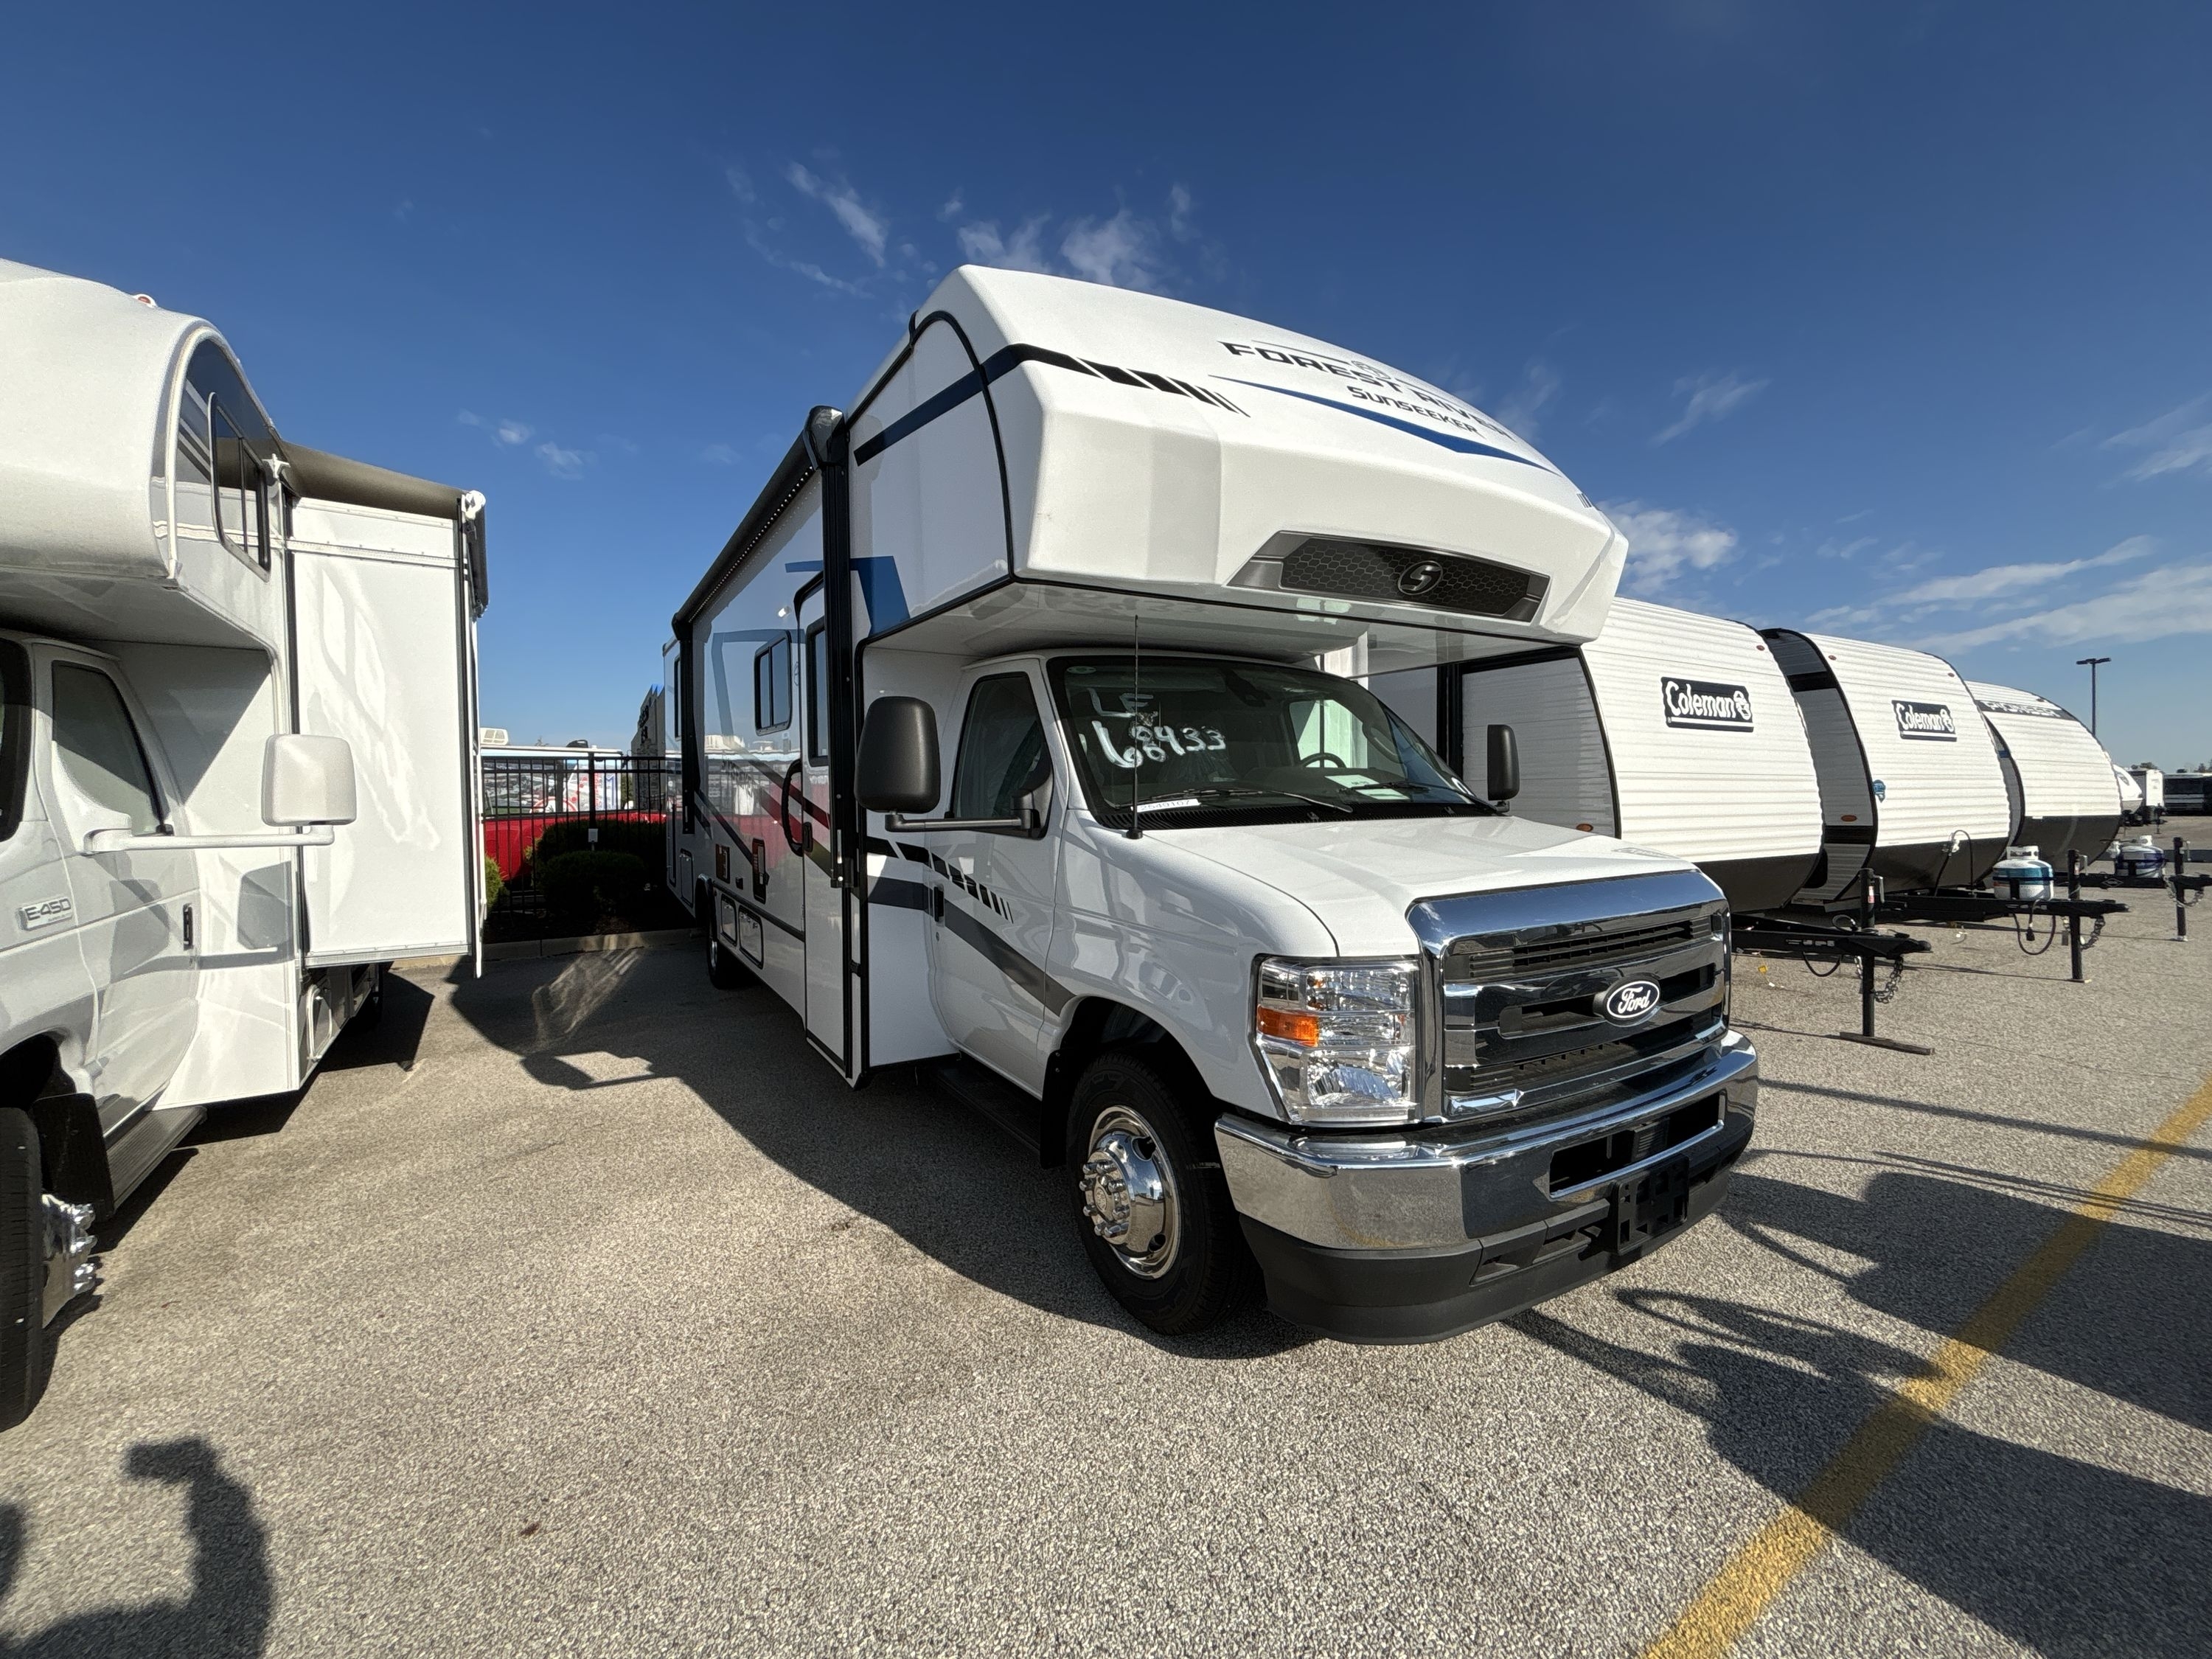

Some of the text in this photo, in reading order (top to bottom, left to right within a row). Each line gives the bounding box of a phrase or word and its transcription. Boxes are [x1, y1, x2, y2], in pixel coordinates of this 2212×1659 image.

[1217, 340, 1402, 393] FOREST
[1665, 681, 1736, 719] Coleman
[1896, 703, 1945, 731] Coleman
[24, 898, 72, 921] E-450
[1617, 986, 1652, 1015] Ford
